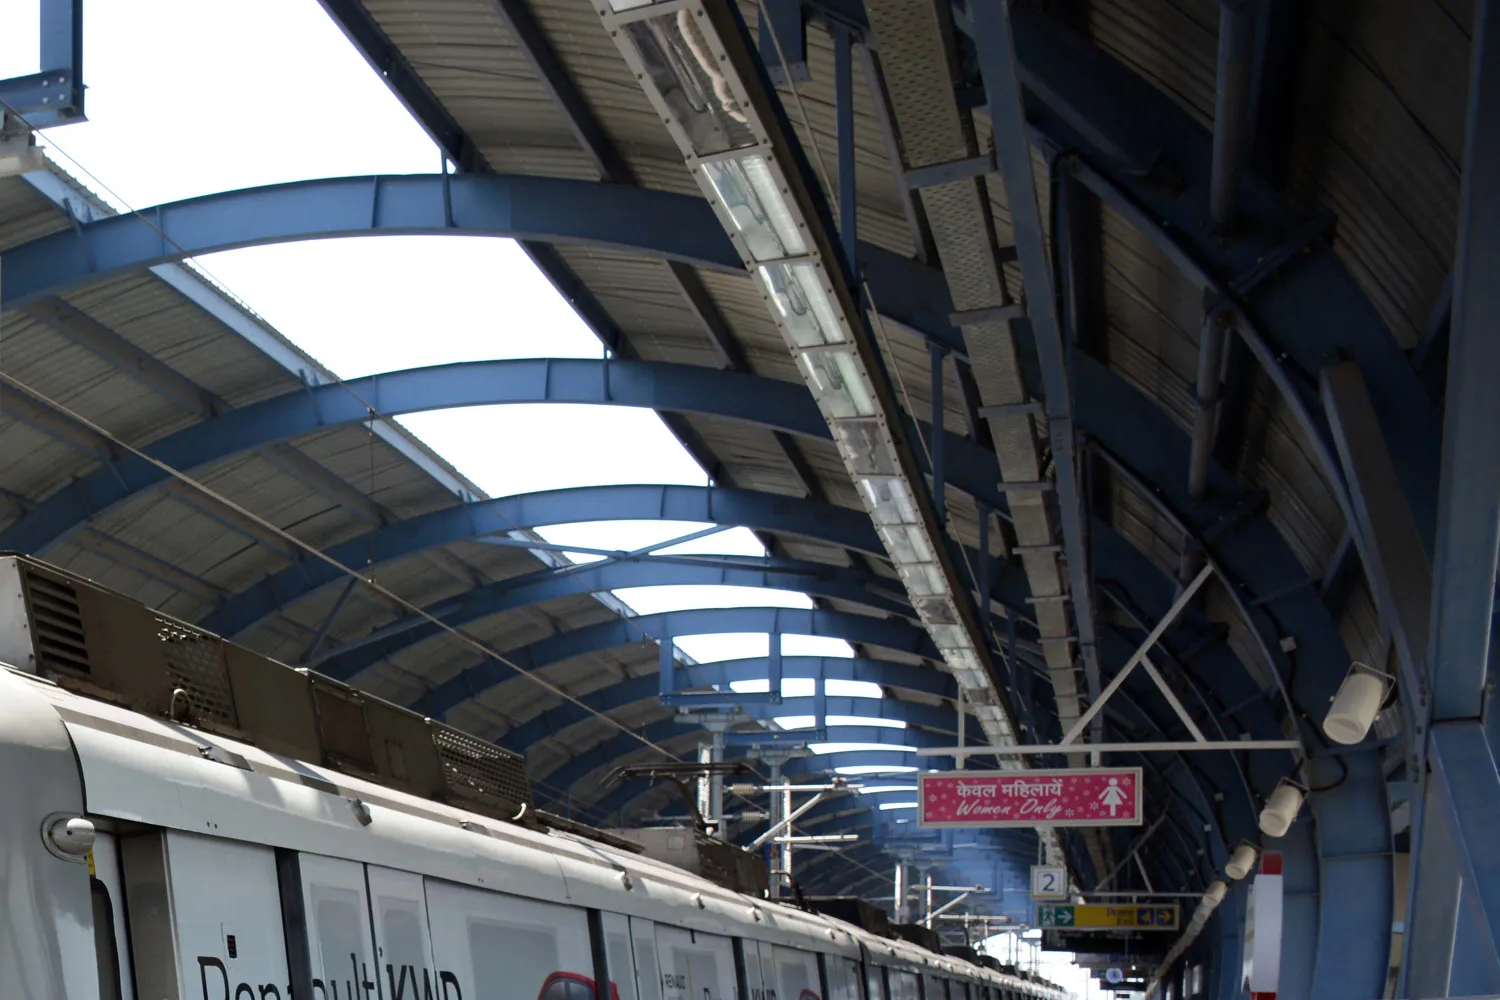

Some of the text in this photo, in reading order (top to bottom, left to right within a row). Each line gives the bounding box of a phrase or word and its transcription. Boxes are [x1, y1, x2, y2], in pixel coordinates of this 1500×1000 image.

[956, 778, 1063, 798] केवल महिलायें
[956, 798, 1062, 819] Women Only
[1042, 873, 1055, 892] 2
